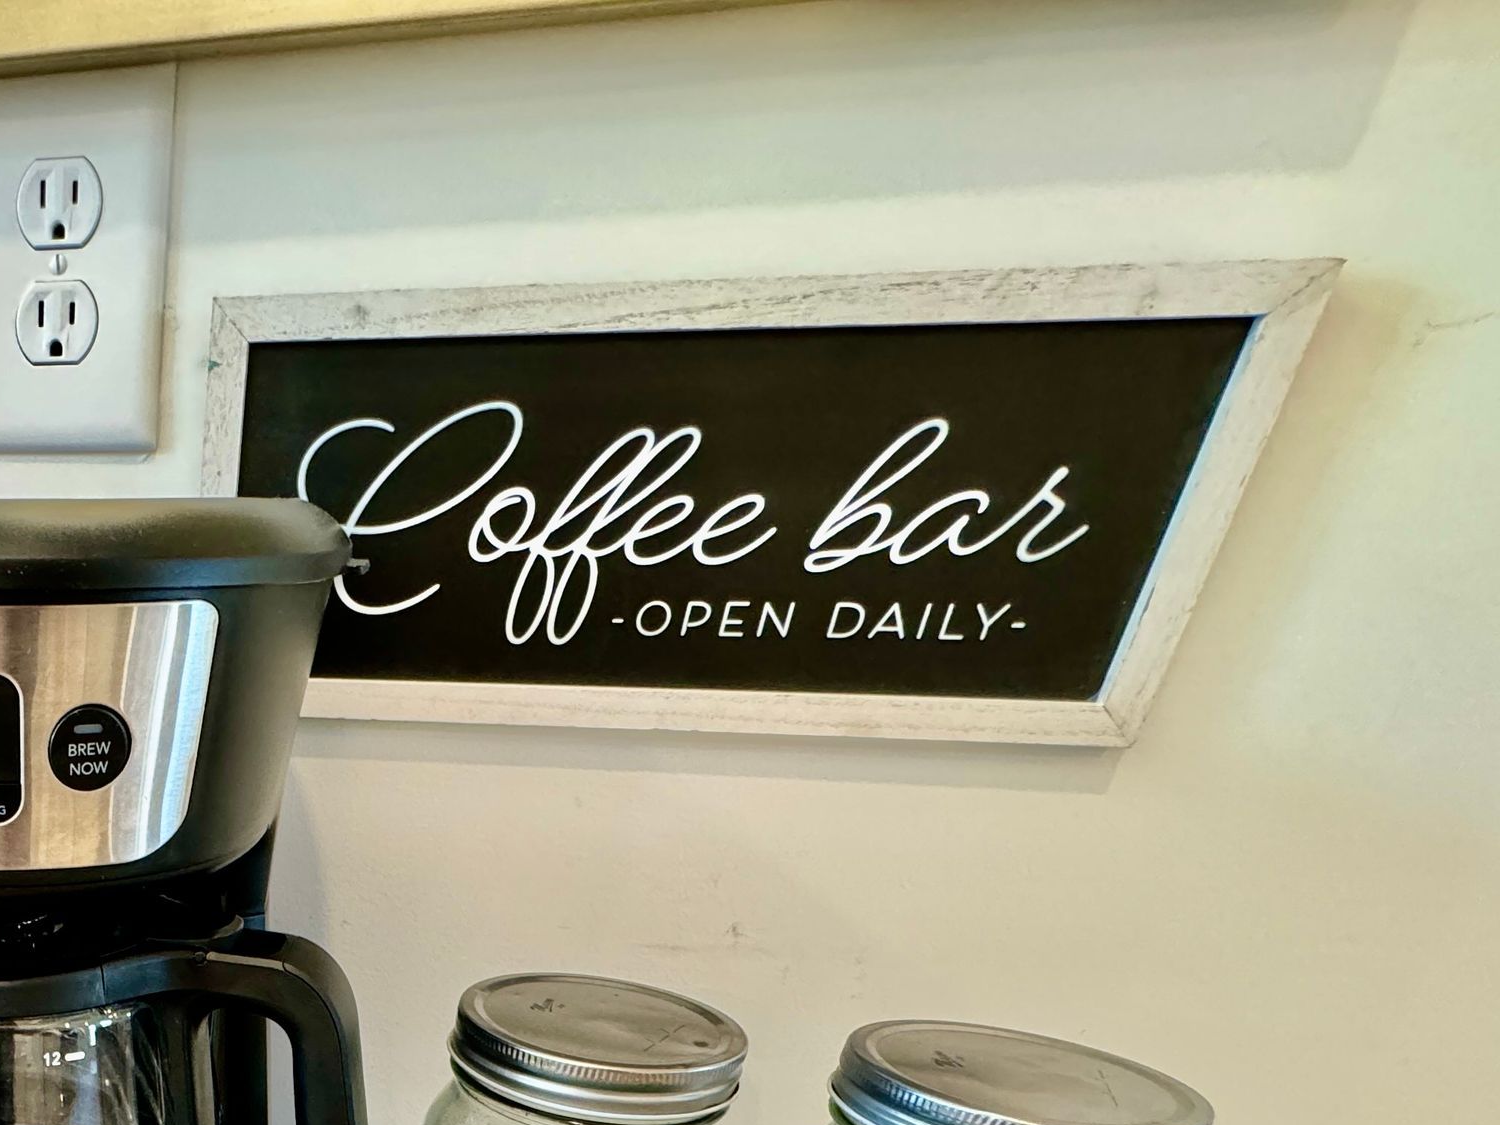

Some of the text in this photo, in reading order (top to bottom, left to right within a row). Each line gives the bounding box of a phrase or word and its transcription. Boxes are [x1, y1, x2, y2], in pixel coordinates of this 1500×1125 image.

[298, 400, 1089, 646] Coffee bar
[67, 740, 112, 757] BREW
[69, 760, 109, 776] NOW
[43, 1051, 61, 1067] 12
